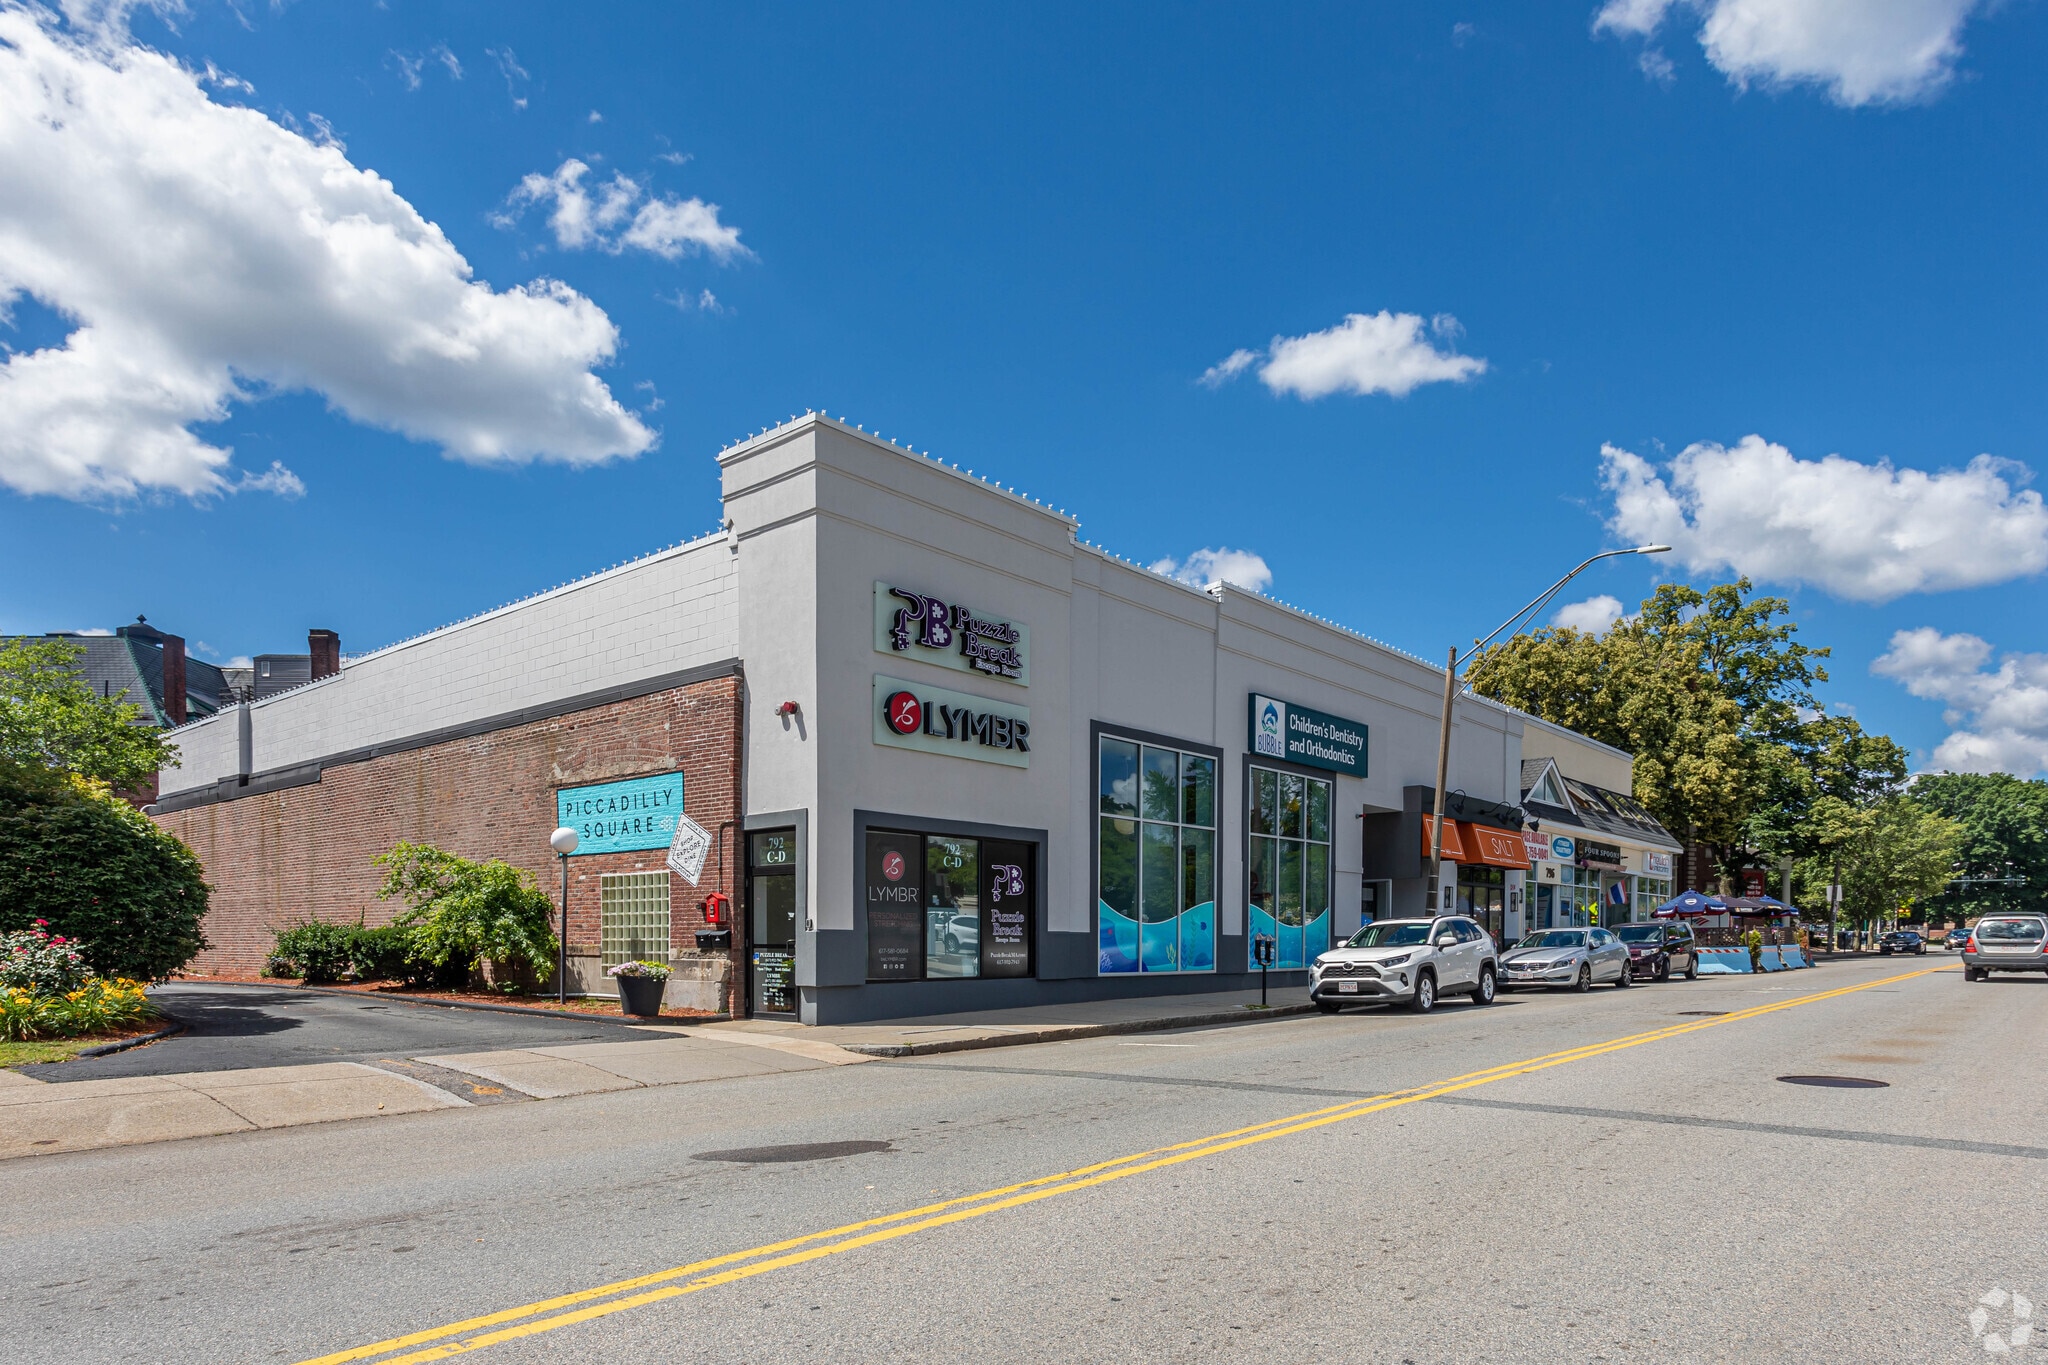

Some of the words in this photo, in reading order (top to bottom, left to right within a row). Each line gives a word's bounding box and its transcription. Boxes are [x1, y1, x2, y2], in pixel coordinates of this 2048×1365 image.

[951, 604, 1021, 646] Puzzle
[961, 631, 1022, 667] Break
[975, 658, 1001, 675] Escape
[1001, 665, 1022, 679] Room
[923, 701, 1031, 752] LYMBR
[1290, 713, 1329, 739] Children's
[1329, 724, 1364, 751] Dentistry
[1257, 733, 1282, 756] BUBBLE
[1289, 738, 1305, 754] and
[1306, 740, 1355, 765] Orthodontics
[566, 788, 673, 817] PICCADILLY
[584, 816, 654, 838] SQUARE
[676, 840, 702, 859] EXPLORE
[680, 835, 694, 847] SHOP
[768, 837, 784, 849] 792
[945, 843, 961, 855] 792
[1491, 837, 1514, 857] SALT
[684, 853, 697, 864] DINE
[766, 850, 786, 863] C-D
[943, 856, 962, 868] C-D
[1584, 846, 1599, 855] FOUR
[1600, 850, 1620, 859] SPOONS
[869, 886, 918, 902] LYMBR
[991, 909, 1024, 923] Puzzle
[992, 922, 1023, 936] Break
